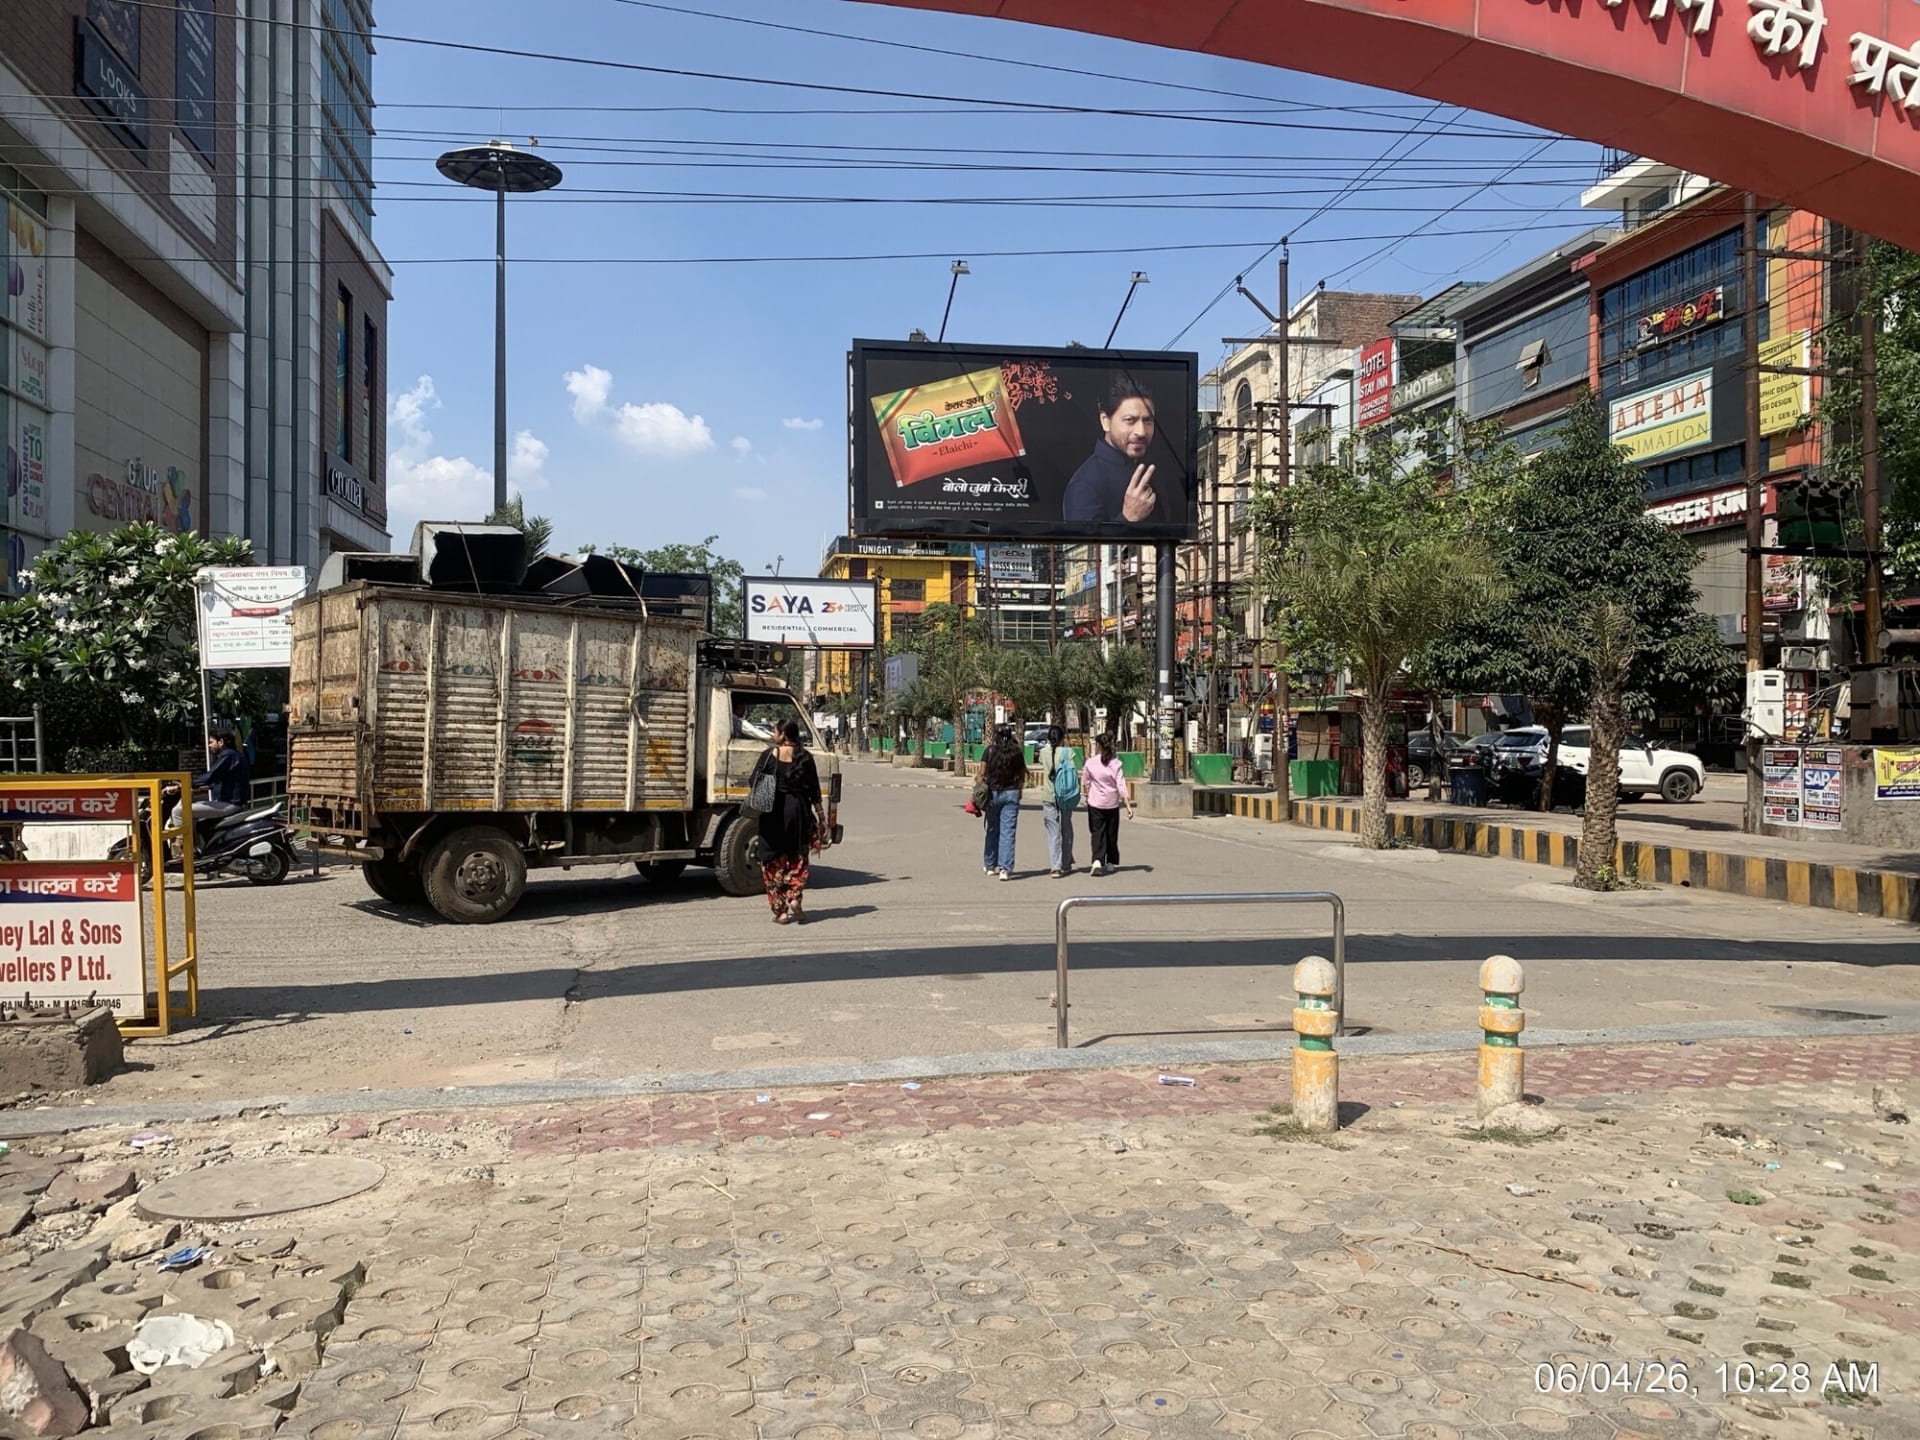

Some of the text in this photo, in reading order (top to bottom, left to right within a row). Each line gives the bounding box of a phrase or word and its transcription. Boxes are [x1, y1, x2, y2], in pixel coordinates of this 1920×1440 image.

[101, 58, 136, 113] LOOKS
[1360, 351, 1387, 378] HOTEL
[1360, 380, 1376, 398] STAY
[1405, 372, 1442, 401] HOTEL
[1616, 381, 1706, 433] ARENA
[29, 436, 42, 461] TO
[942, 477, 967, 493] बोलो
[858, 545, 892, 555] TUNIGHT
[751, 595, 813, 614] SAYA
[1805, 770, 1831, 787] SAP
[14, 798, 76, 814] पालन
[81, 792, 119, 814] करें
[17, 878, 78, 895] पालन
[82, 872, 121, 894] करें
[29, 920, 55, 945] Lal
[61, 919, 74, 945] &
[80, 919, 122, 945] Sons
[61, 956, 72, 981] P
[78, 955, 112, 981] Ltd.
